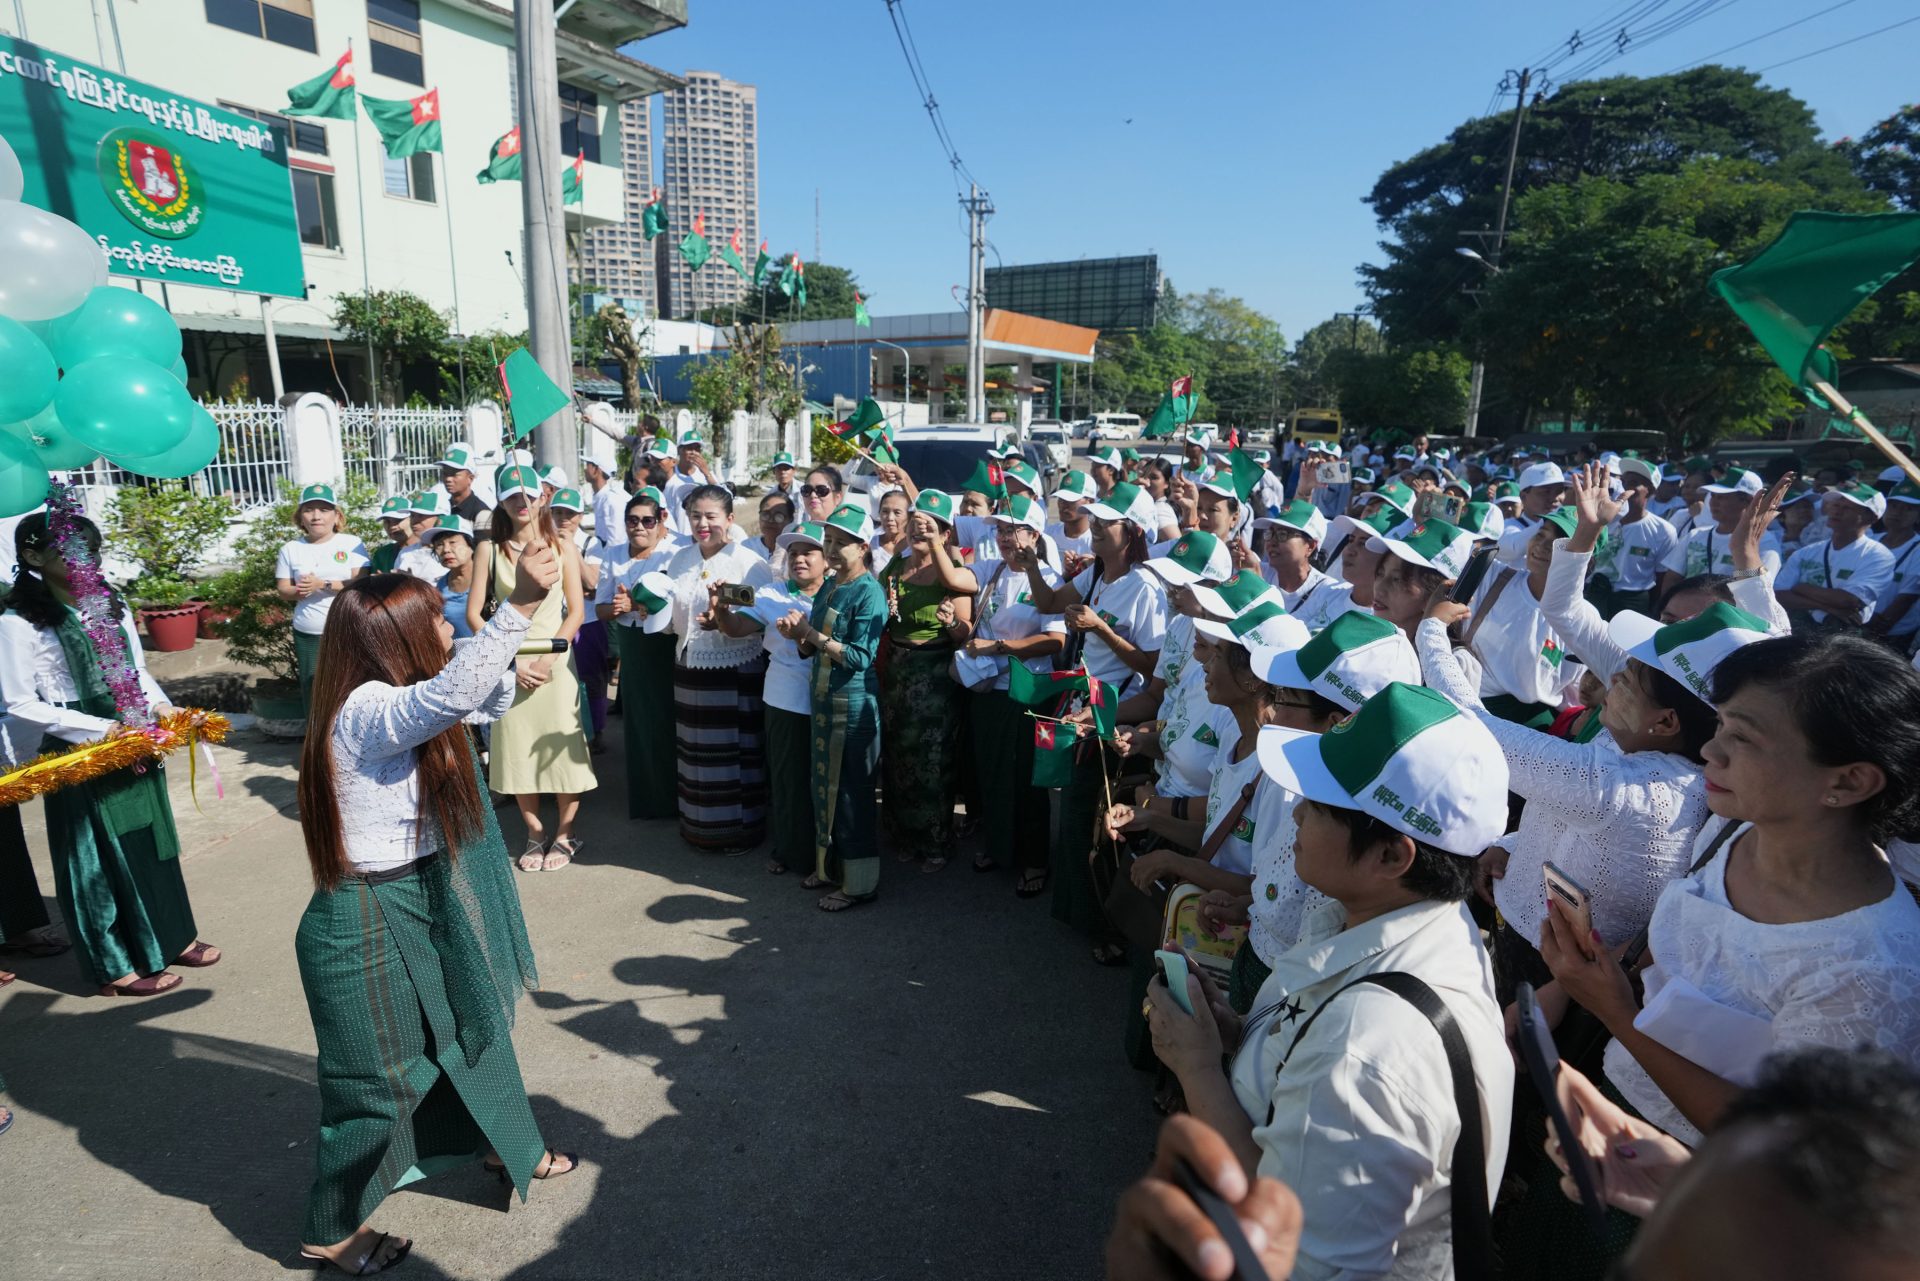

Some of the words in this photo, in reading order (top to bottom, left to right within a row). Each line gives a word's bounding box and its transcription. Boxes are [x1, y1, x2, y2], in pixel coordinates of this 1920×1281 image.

[97, 235, 244, 284] န်ကုန်တိုင်းဒေသကြီး
